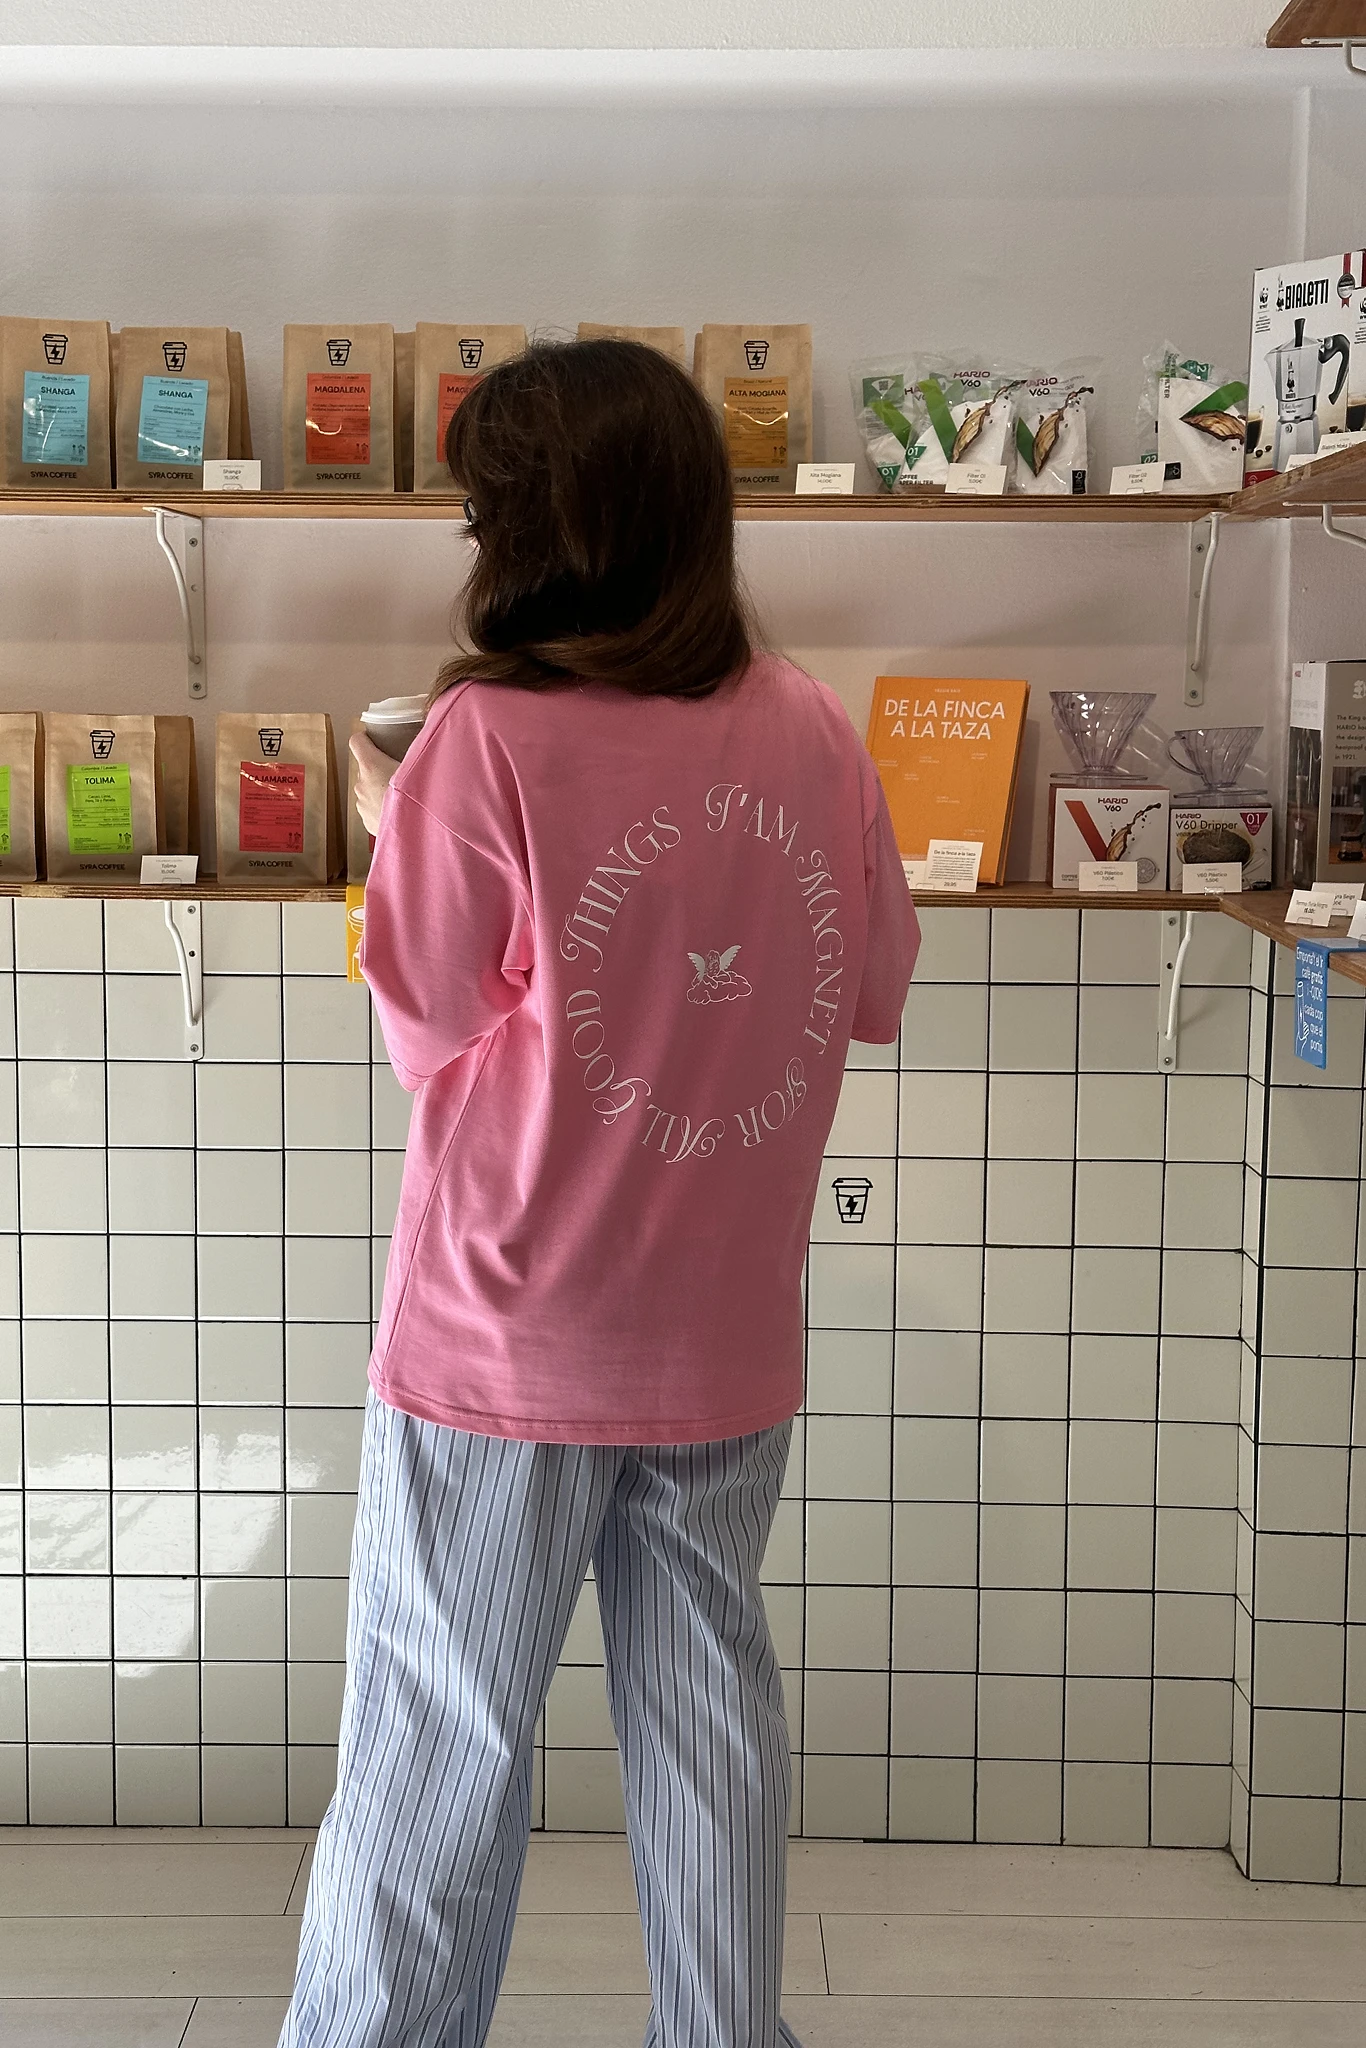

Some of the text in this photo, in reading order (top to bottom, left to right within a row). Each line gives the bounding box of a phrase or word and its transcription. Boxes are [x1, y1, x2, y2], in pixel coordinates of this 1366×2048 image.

[960, 379, 982, 388] V60
[1025, 377, 1058, 388] ARIO
[40, 386, 76, 396] SHANGA
[158, 389, 194, 399] SHANGA
[749, 389, 787, 397] MOGIANA
[1029, 388, 1050, 397] V60
[907, 447, 919, 456] 01
[49, 471, 77, 479] COFFEE
[148, 471, 194, 480] SYRA COFFEE
[316, 472, 361, 480] SYRA COFFEE
[881, 467, 894, 476] 01
[753, 475, 780, 483] COFFEE
[884, 699, 1005, 719] DE LA FINCA
[890, 720, 991, 740] A LA TAZA
[84, 777, 116, 785] TOLIMA
[1246, 813, 1260, 825] 01
[1176, 820, 1197, 830] V60
[1200, 820, 1238, 832] Dripper
[248, 860, 266, 868] SYRA
[559, 805, 682, 973] THINGS
[793, 849, 845, 1055] MAGNET
[1311, 971, 1323, 985] gratis
[565, 988, 652, 1125] GOOD
[733, 1056, 808, 1148] FOR
[640, 1102, 726, 1164] ALL
